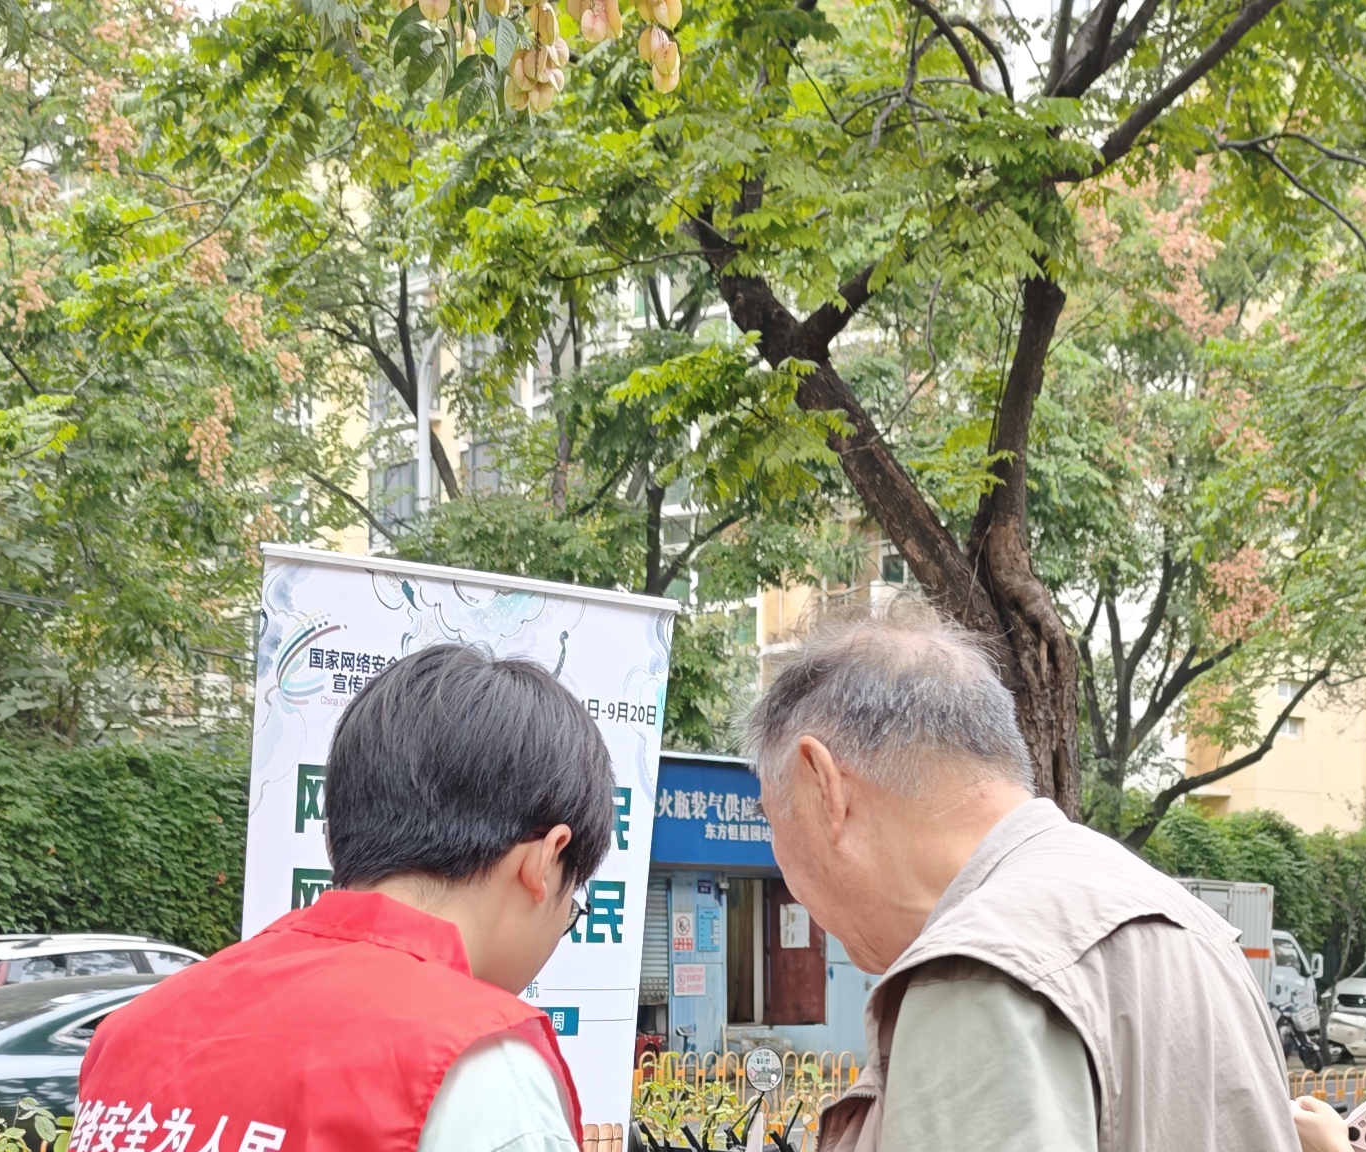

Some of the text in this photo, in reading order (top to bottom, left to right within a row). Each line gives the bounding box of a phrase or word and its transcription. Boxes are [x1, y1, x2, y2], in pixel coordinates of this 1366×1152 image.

[581, 699, 657, 726] 日-9月20日
[654, 788, 767, 823] 火瓶装气供应
